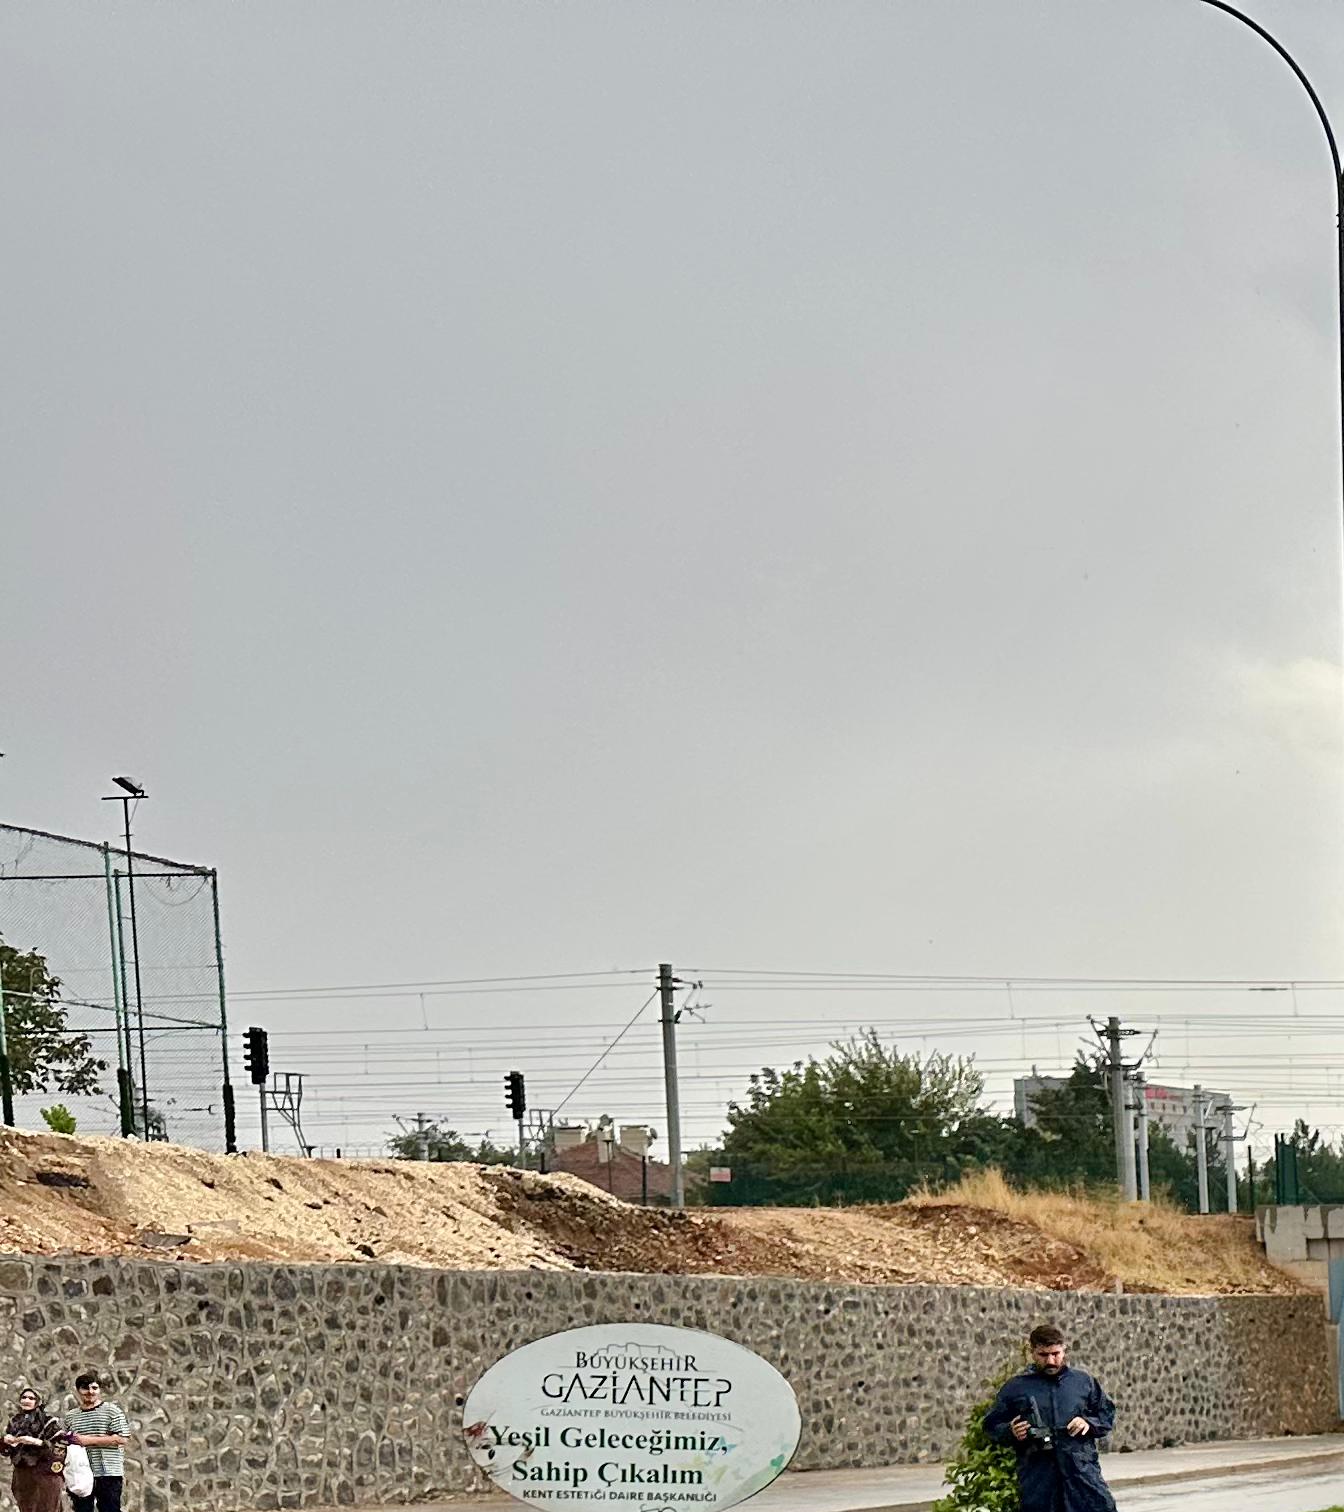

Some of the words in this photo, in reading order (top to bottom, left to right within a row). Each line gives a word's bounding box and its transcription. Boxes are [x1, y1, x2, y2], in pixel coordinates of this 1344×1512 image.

[541, 1371, 732, 1407] GAZİANTEP
[490, 1425, 550, 1452] Yeşil
[560, 1426, 728, 1455] Geleceğimiz,
[512, 1460, 588, 1488] Sahip
[598, 1461, 704, 1487] Çıkalım
[523, 1489, 552, 1499] KENT
